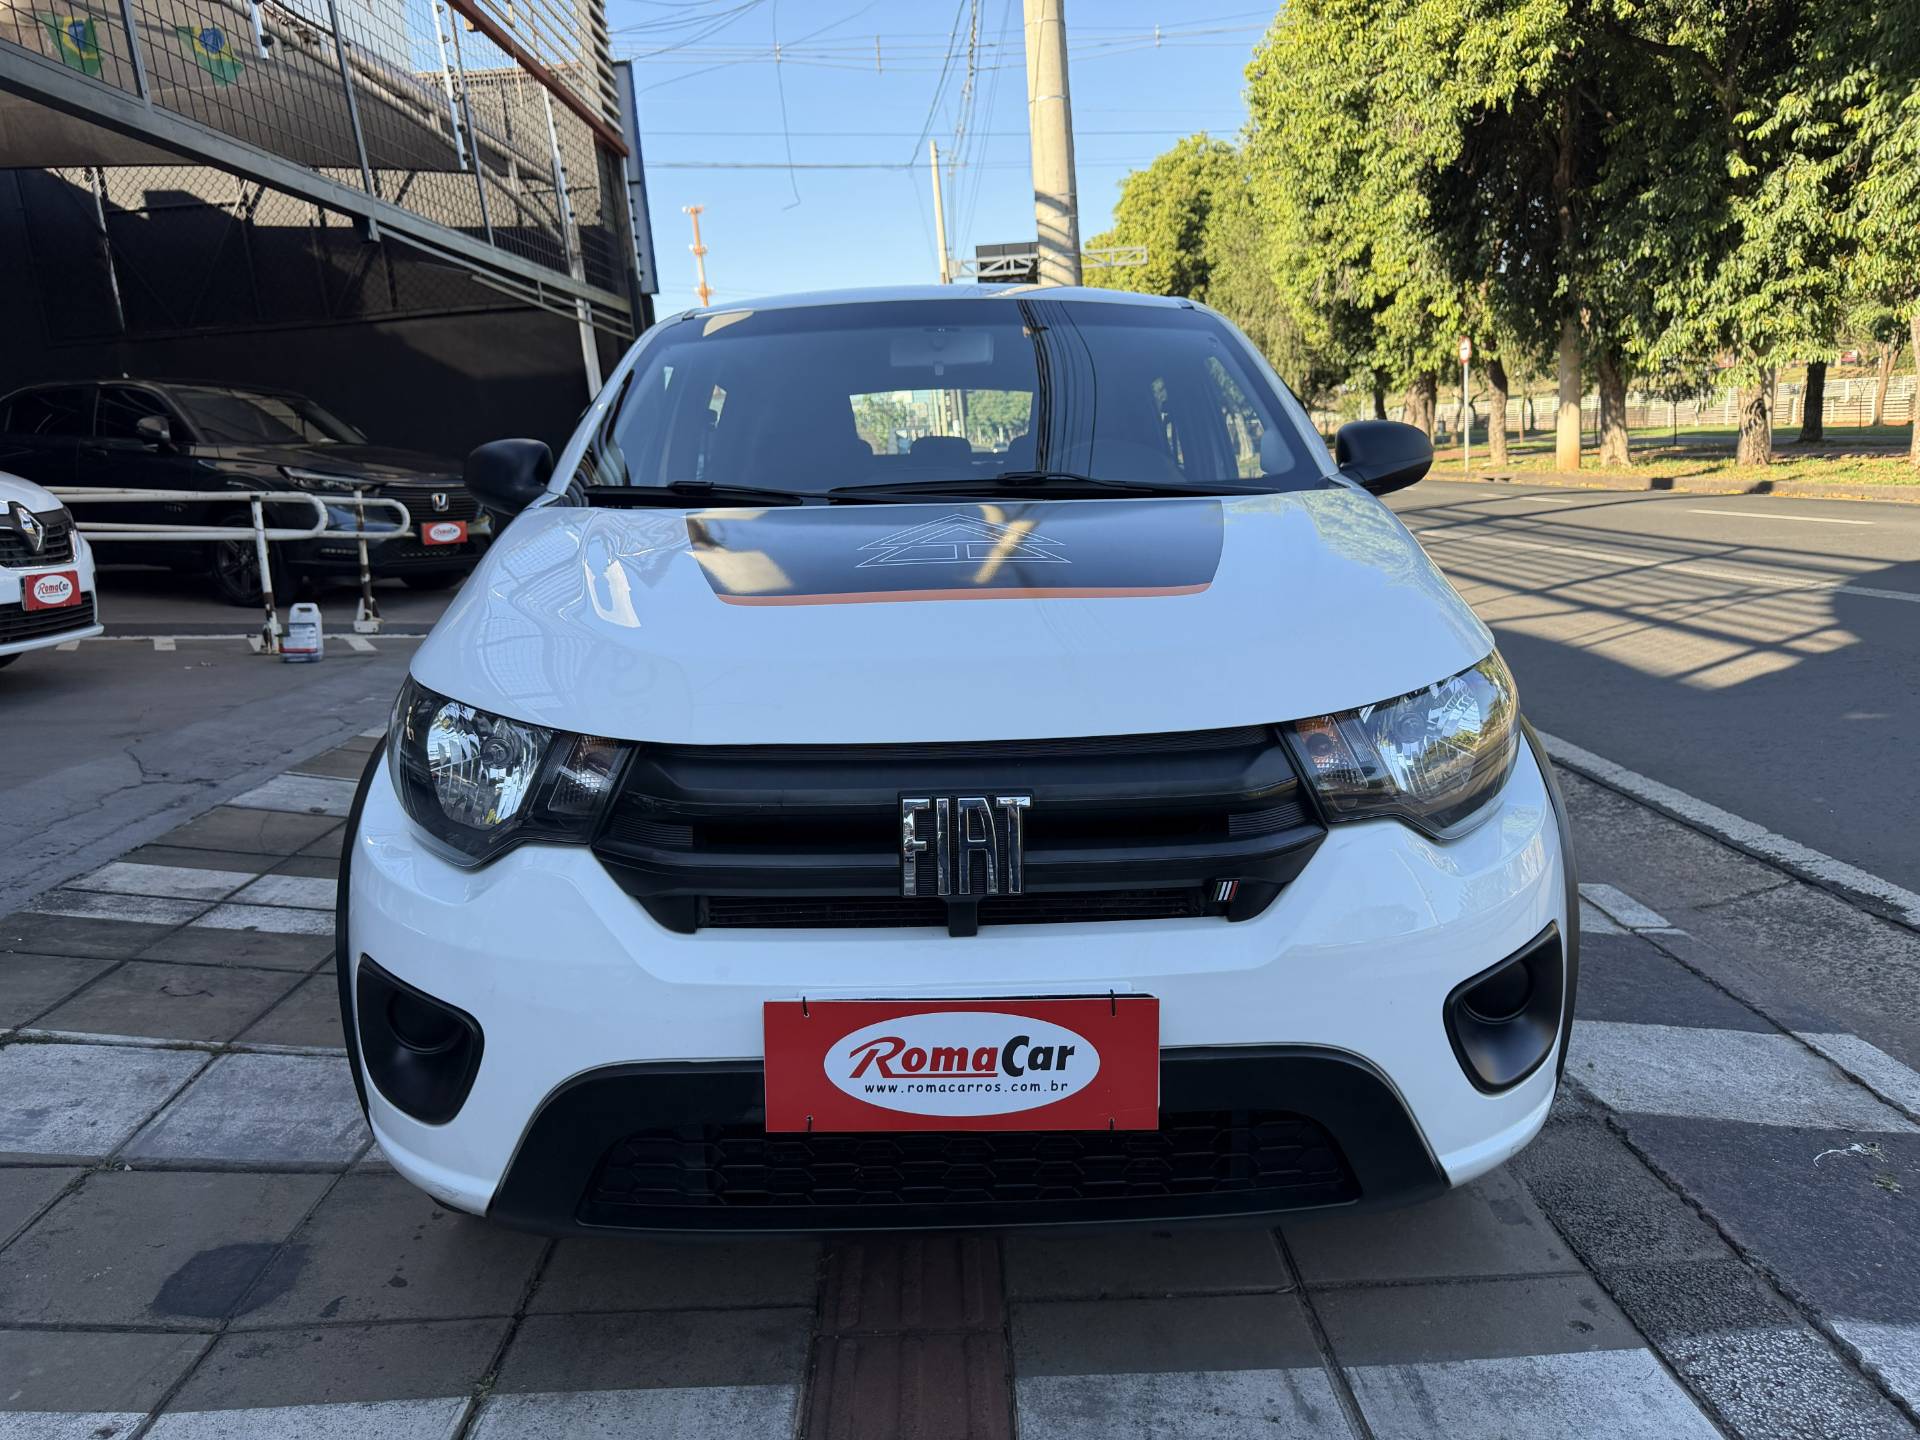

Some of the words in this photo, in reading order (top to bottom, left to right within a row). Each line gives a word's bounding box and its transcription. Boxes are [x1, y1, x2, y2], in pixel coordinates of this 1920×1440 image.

[902, 796, 1031, 896] FIAT
[848, 1035, 1075, 1079] RomaCar
[864, 1080, 1068, 1094] www.romacarros.com.br
